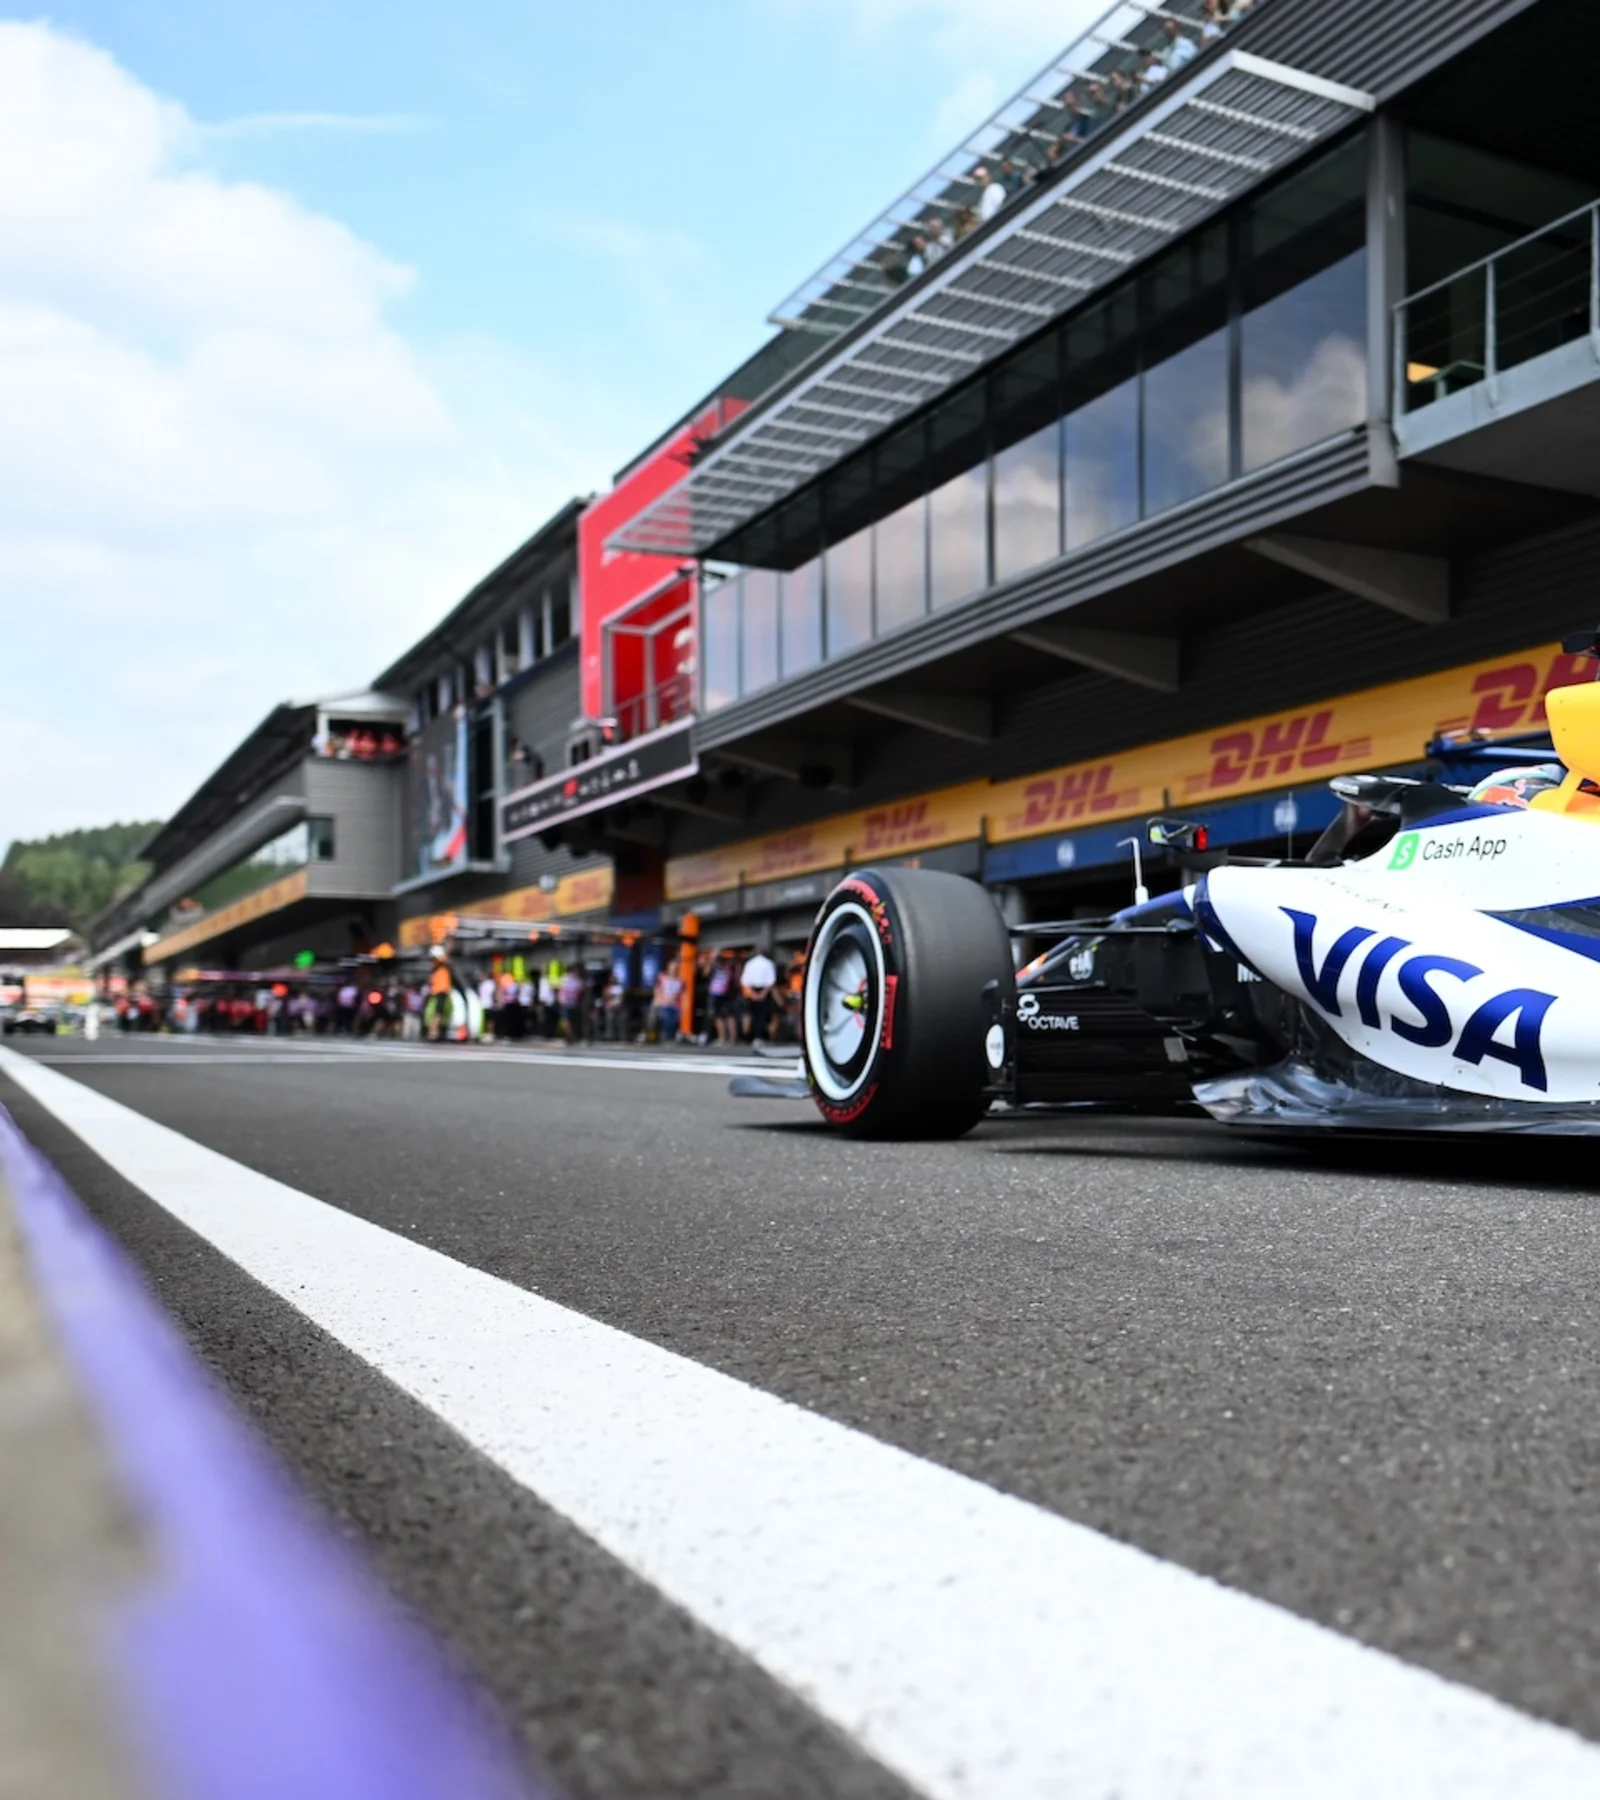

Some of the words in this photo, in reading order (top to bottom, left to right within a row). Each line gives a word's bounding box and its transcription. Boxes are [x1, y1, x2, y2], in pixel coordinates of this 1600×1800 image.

[1209, 709, 1342, 788] DHL
[1024, 764, 1118, 827] DHL
[1422, 836, 1464, 861] Cash
[1467, 835, 1507, 860] App
[1028, 1016, 1080, 1030] OCTAVE
[1278, 905, 1559, 1092] VISA
